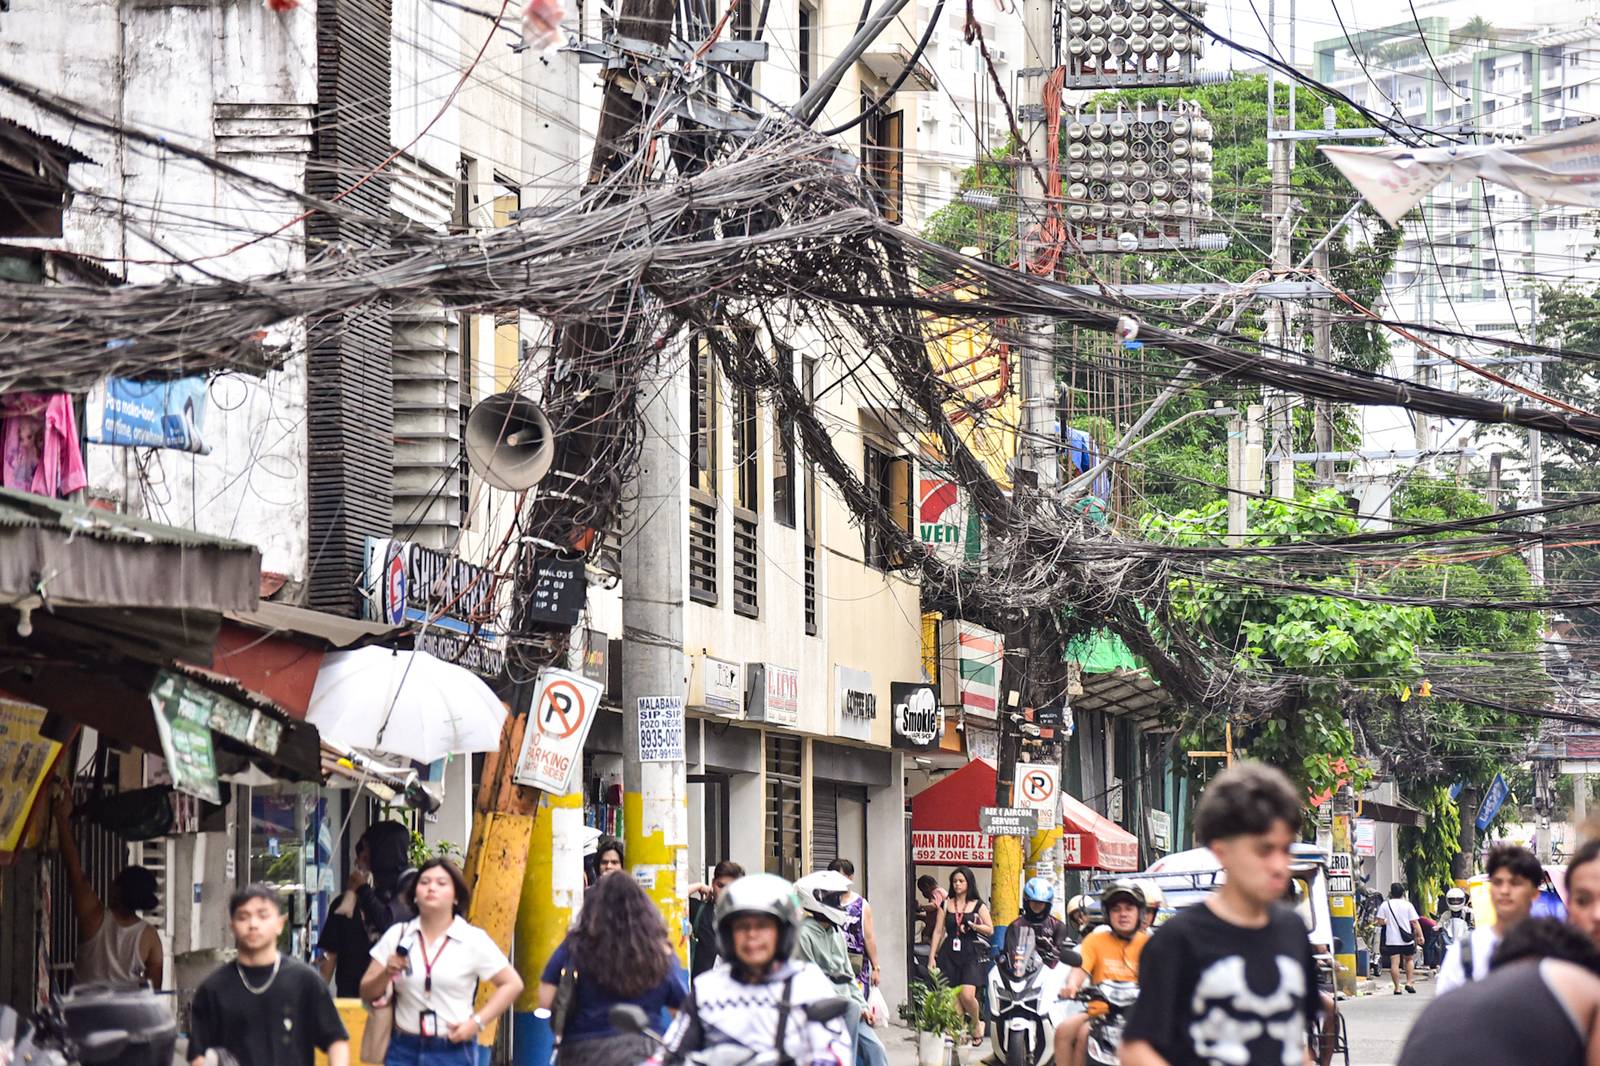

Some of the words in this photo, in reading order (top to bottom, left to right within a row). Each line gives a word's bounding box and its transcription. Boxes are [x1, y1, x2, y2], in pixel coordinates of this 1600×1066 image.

[640, 720, 660, 728] POZO
[991, 817, 1020, 825] SERVICE
[938, 834, 975, 849] RHODEL
[917, 851, 936, 860] 592
[939, 851, 968, 860] ZONE
[972, 852, 984, 860] 58
